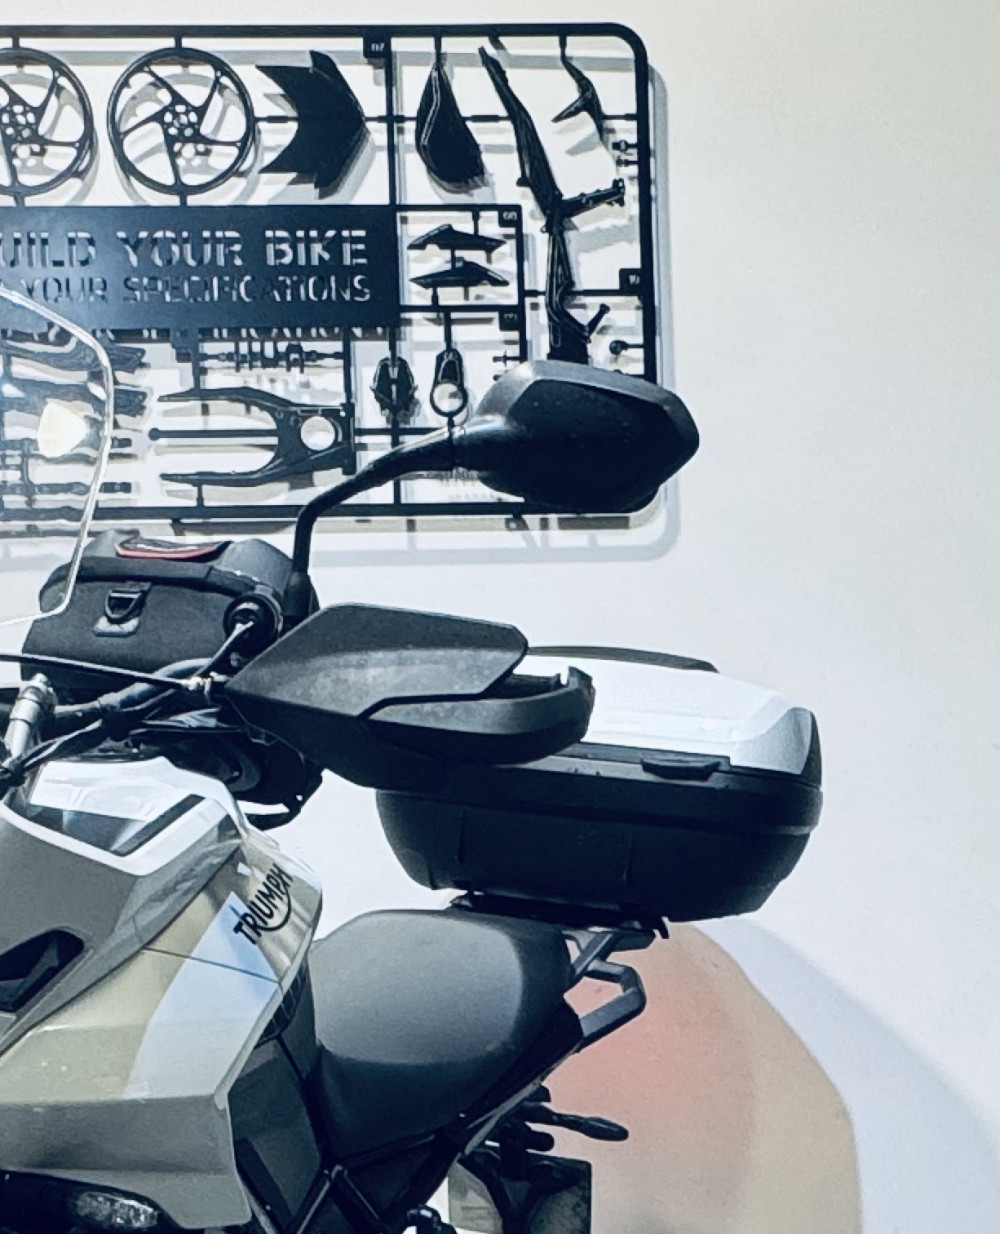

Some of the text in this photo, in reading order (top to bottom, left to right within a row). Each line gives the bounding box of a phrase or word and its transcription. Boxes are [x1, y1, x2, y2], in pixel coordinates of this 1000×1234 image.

[116, 230, 243, 267] YOUR
[264, 229, 368, 266] BIKE
[20, 276, 108, 302] YOUR
[122, 274, 371, 302] SPECIFICATIONS
[232, 862, 294, 945] TRIUMPH
